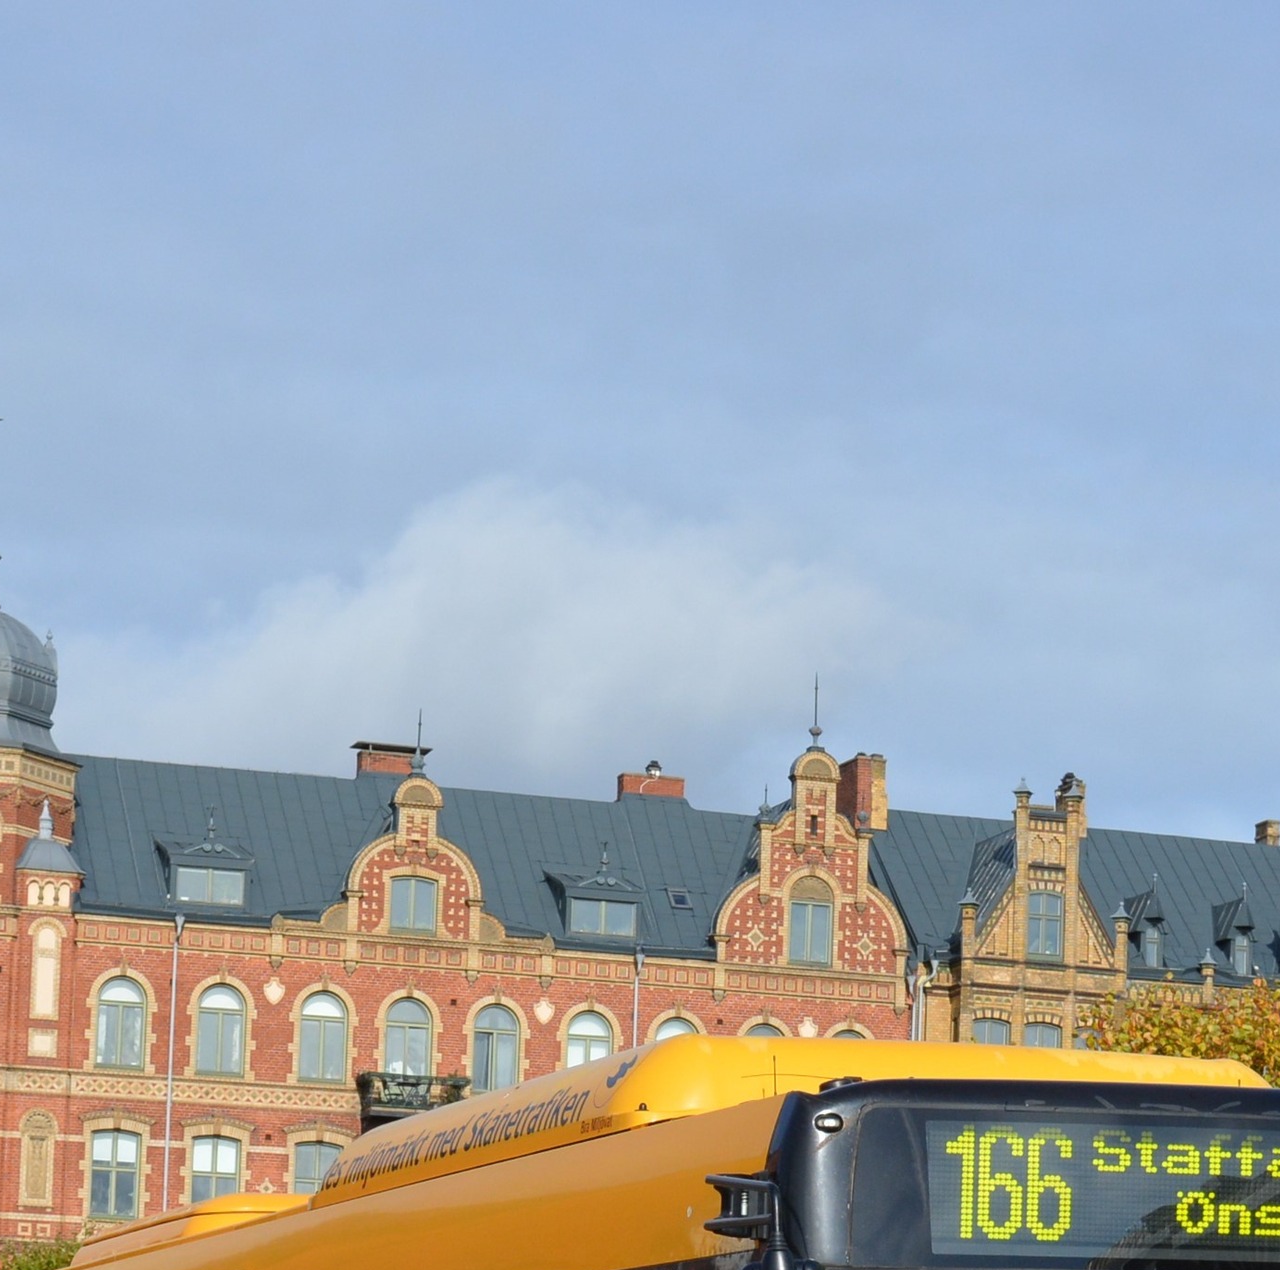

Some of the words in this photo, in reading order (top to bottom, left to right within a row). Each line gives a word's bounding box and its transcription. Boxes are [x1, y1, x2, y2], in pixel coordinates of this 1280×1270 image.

[342, 1128, 429, 1189] miljömärkt
[424, 1122, 467, 1163] med
[463, 1085, 591, 1152] Skånetrafiken
[946, 1124, 1073, 1241] 166
